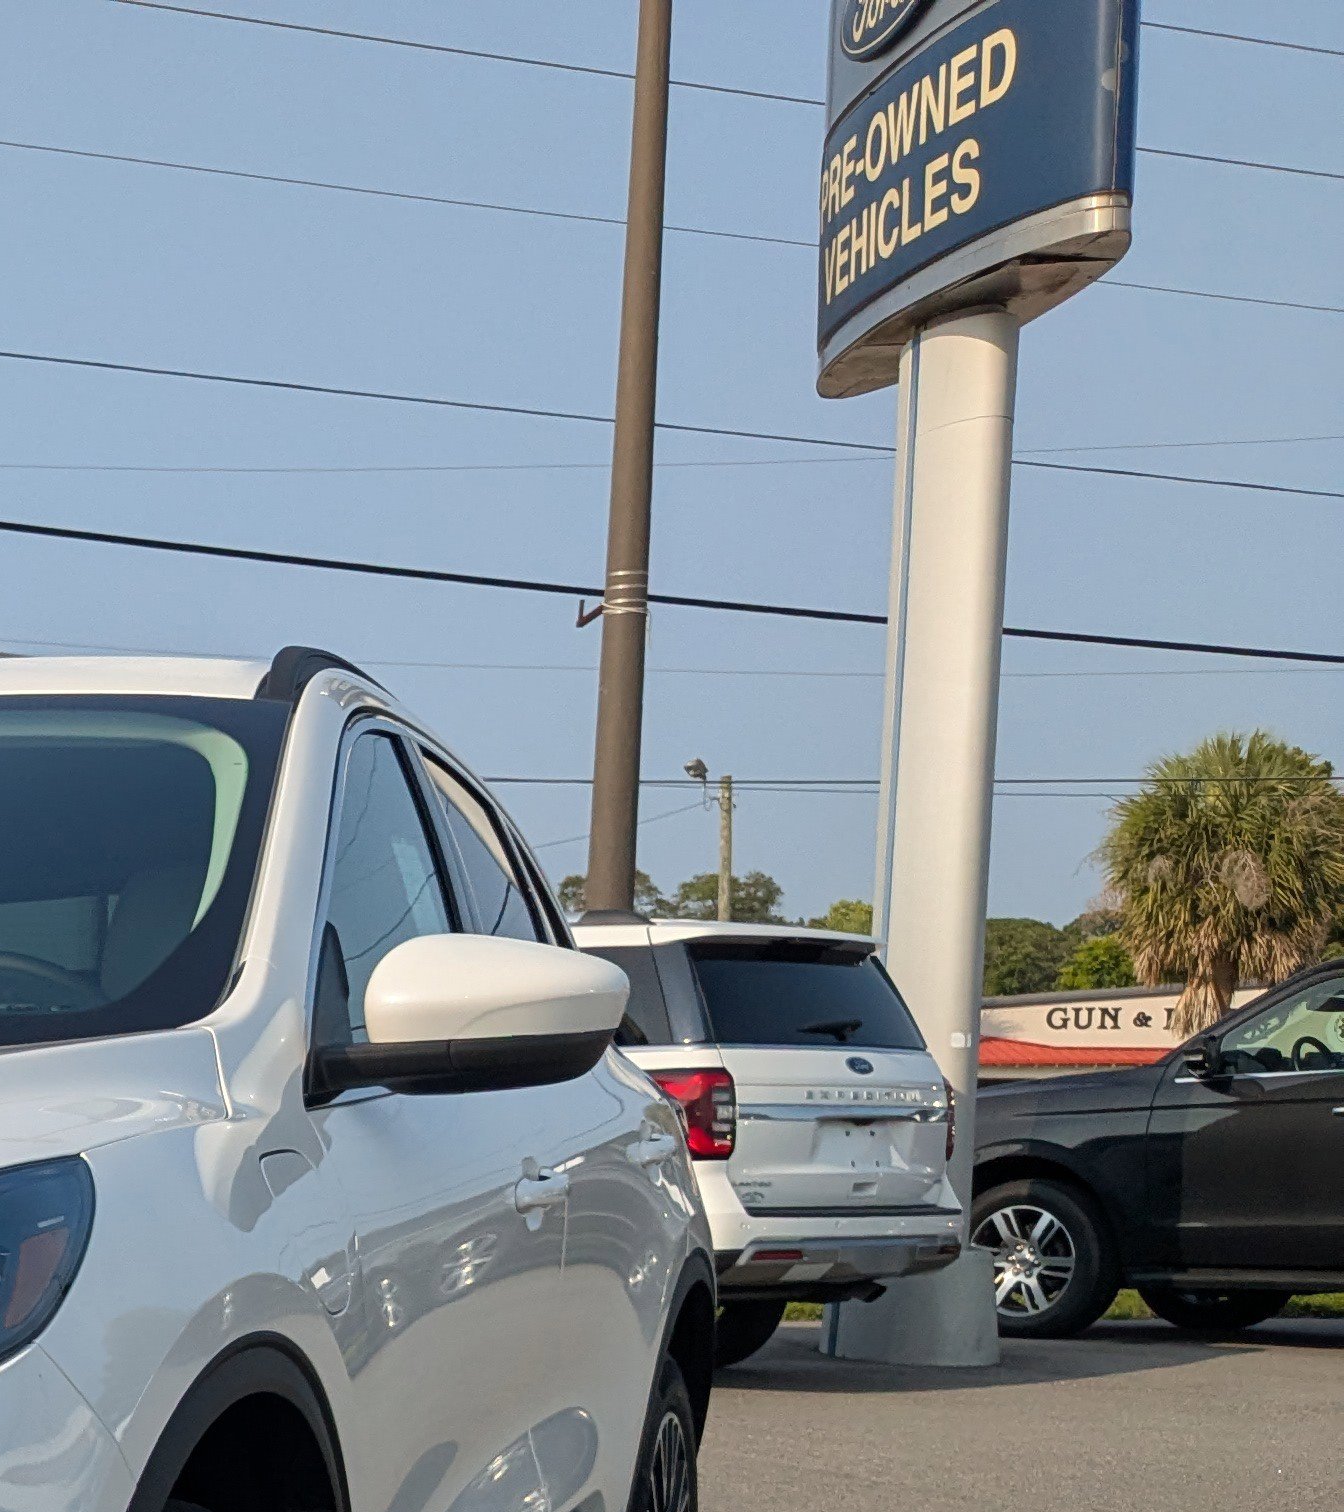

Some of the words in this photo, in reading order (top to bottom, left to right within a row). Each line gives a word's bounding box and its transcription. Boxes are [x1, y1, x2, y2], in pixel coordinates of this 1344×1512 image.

[820, 28, 1017, 234] PRE-OWNED
[824, 138, 981, 305] VEHICLES
[1046, 1006, 1123, 1030] GUN
[1132, 1011, 1153, 1028] &
